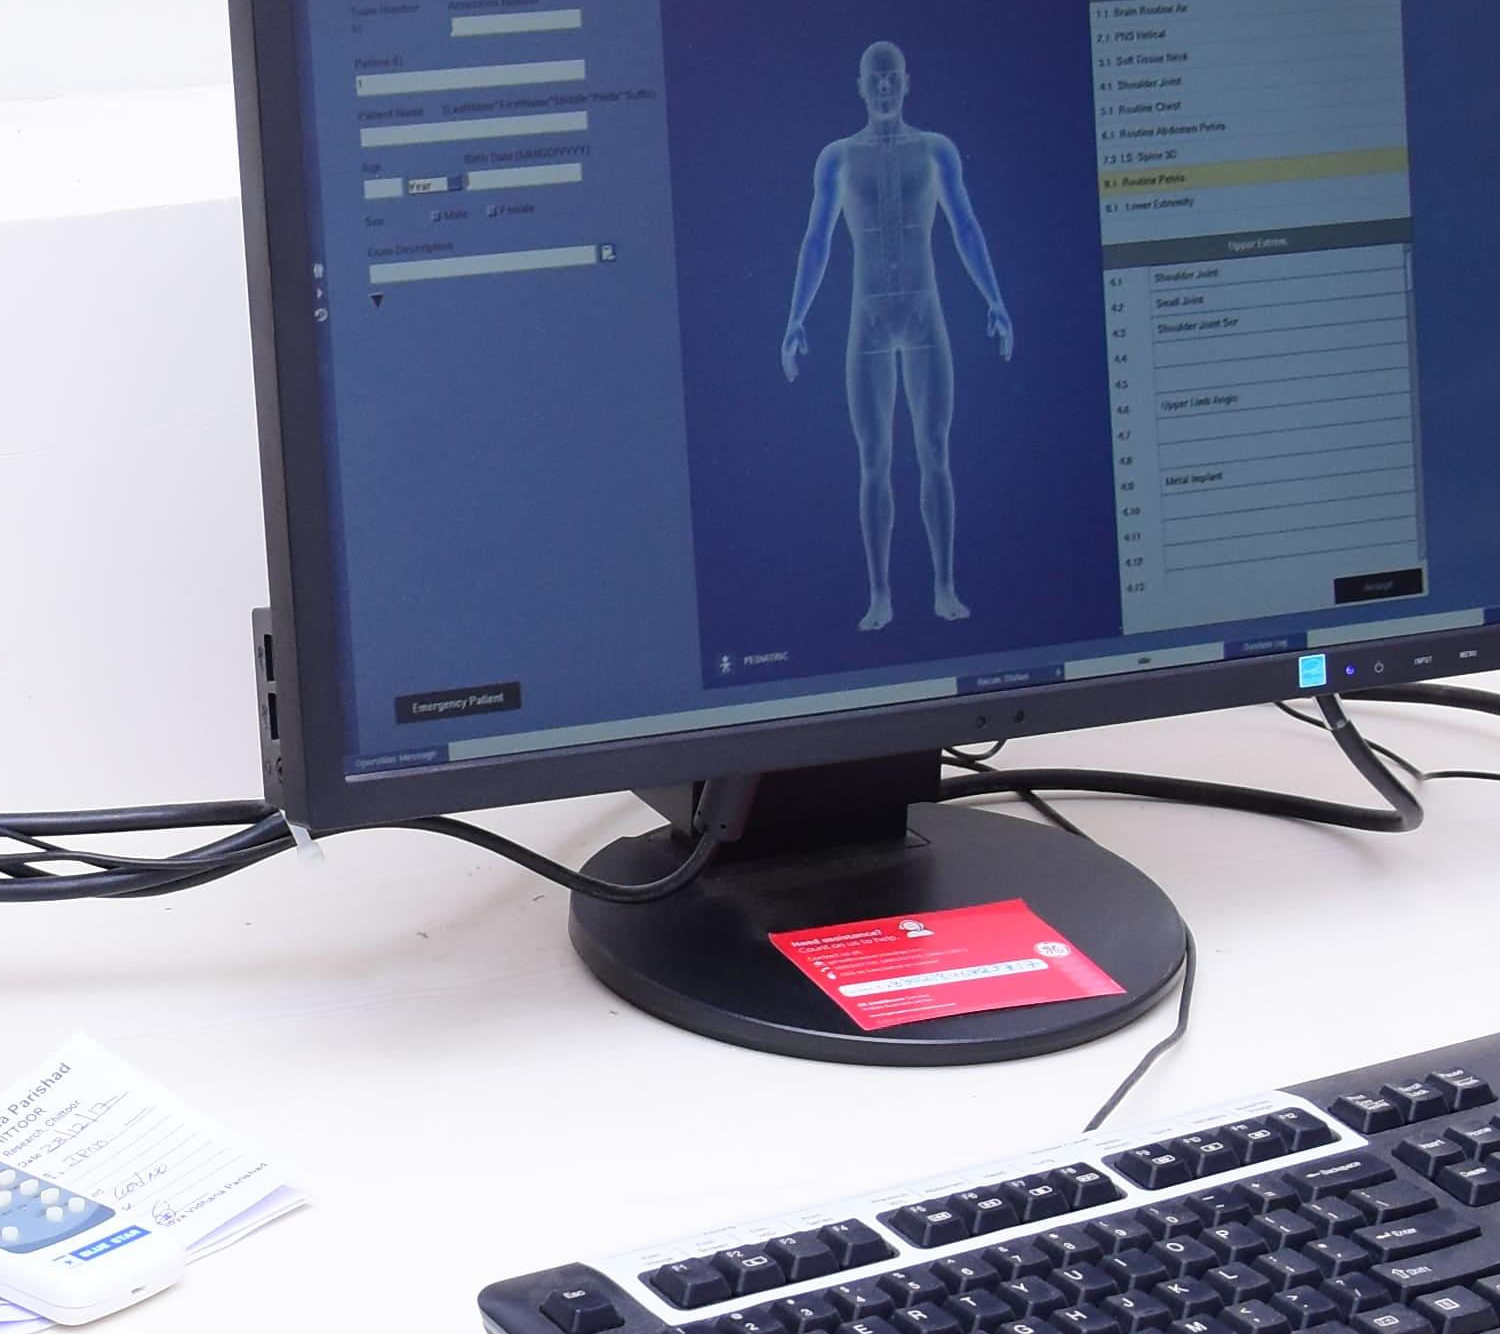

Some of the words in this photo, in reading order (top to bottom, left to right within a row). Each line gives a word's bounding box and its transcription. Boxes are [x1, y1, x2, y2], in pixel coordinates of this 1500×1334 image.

[411, 694, 469, 715] Emergency
[468, 690, 506, 710] Patient
[7, 1061, 73, 1116] Parishad
[44, 1098, 83, 1129] Chittoor
[1215, 1228, 1230, 1240] P
[78, 1241, 111, 1258] BLUE
[109, 1228, 143, 1246] STAR
[1165, 1241, 1185, 1253] O
[1063, 1269, 1085, 1281] U
[1217, 1269, 1239, 1281] L
[1011, 1281, 1030, 1294] Y
[1167, 1282, 1191, 1295] K
[562, 1289, 587, 1300] Esc
[959, 1295, 977, 1307] T
[1121, 1297, 1136, 1309] J
[906, 1308, 928, 1321] R
[1065, 1310, 1088, 1322] H
[1184, 1321, 1209, 1334] M
